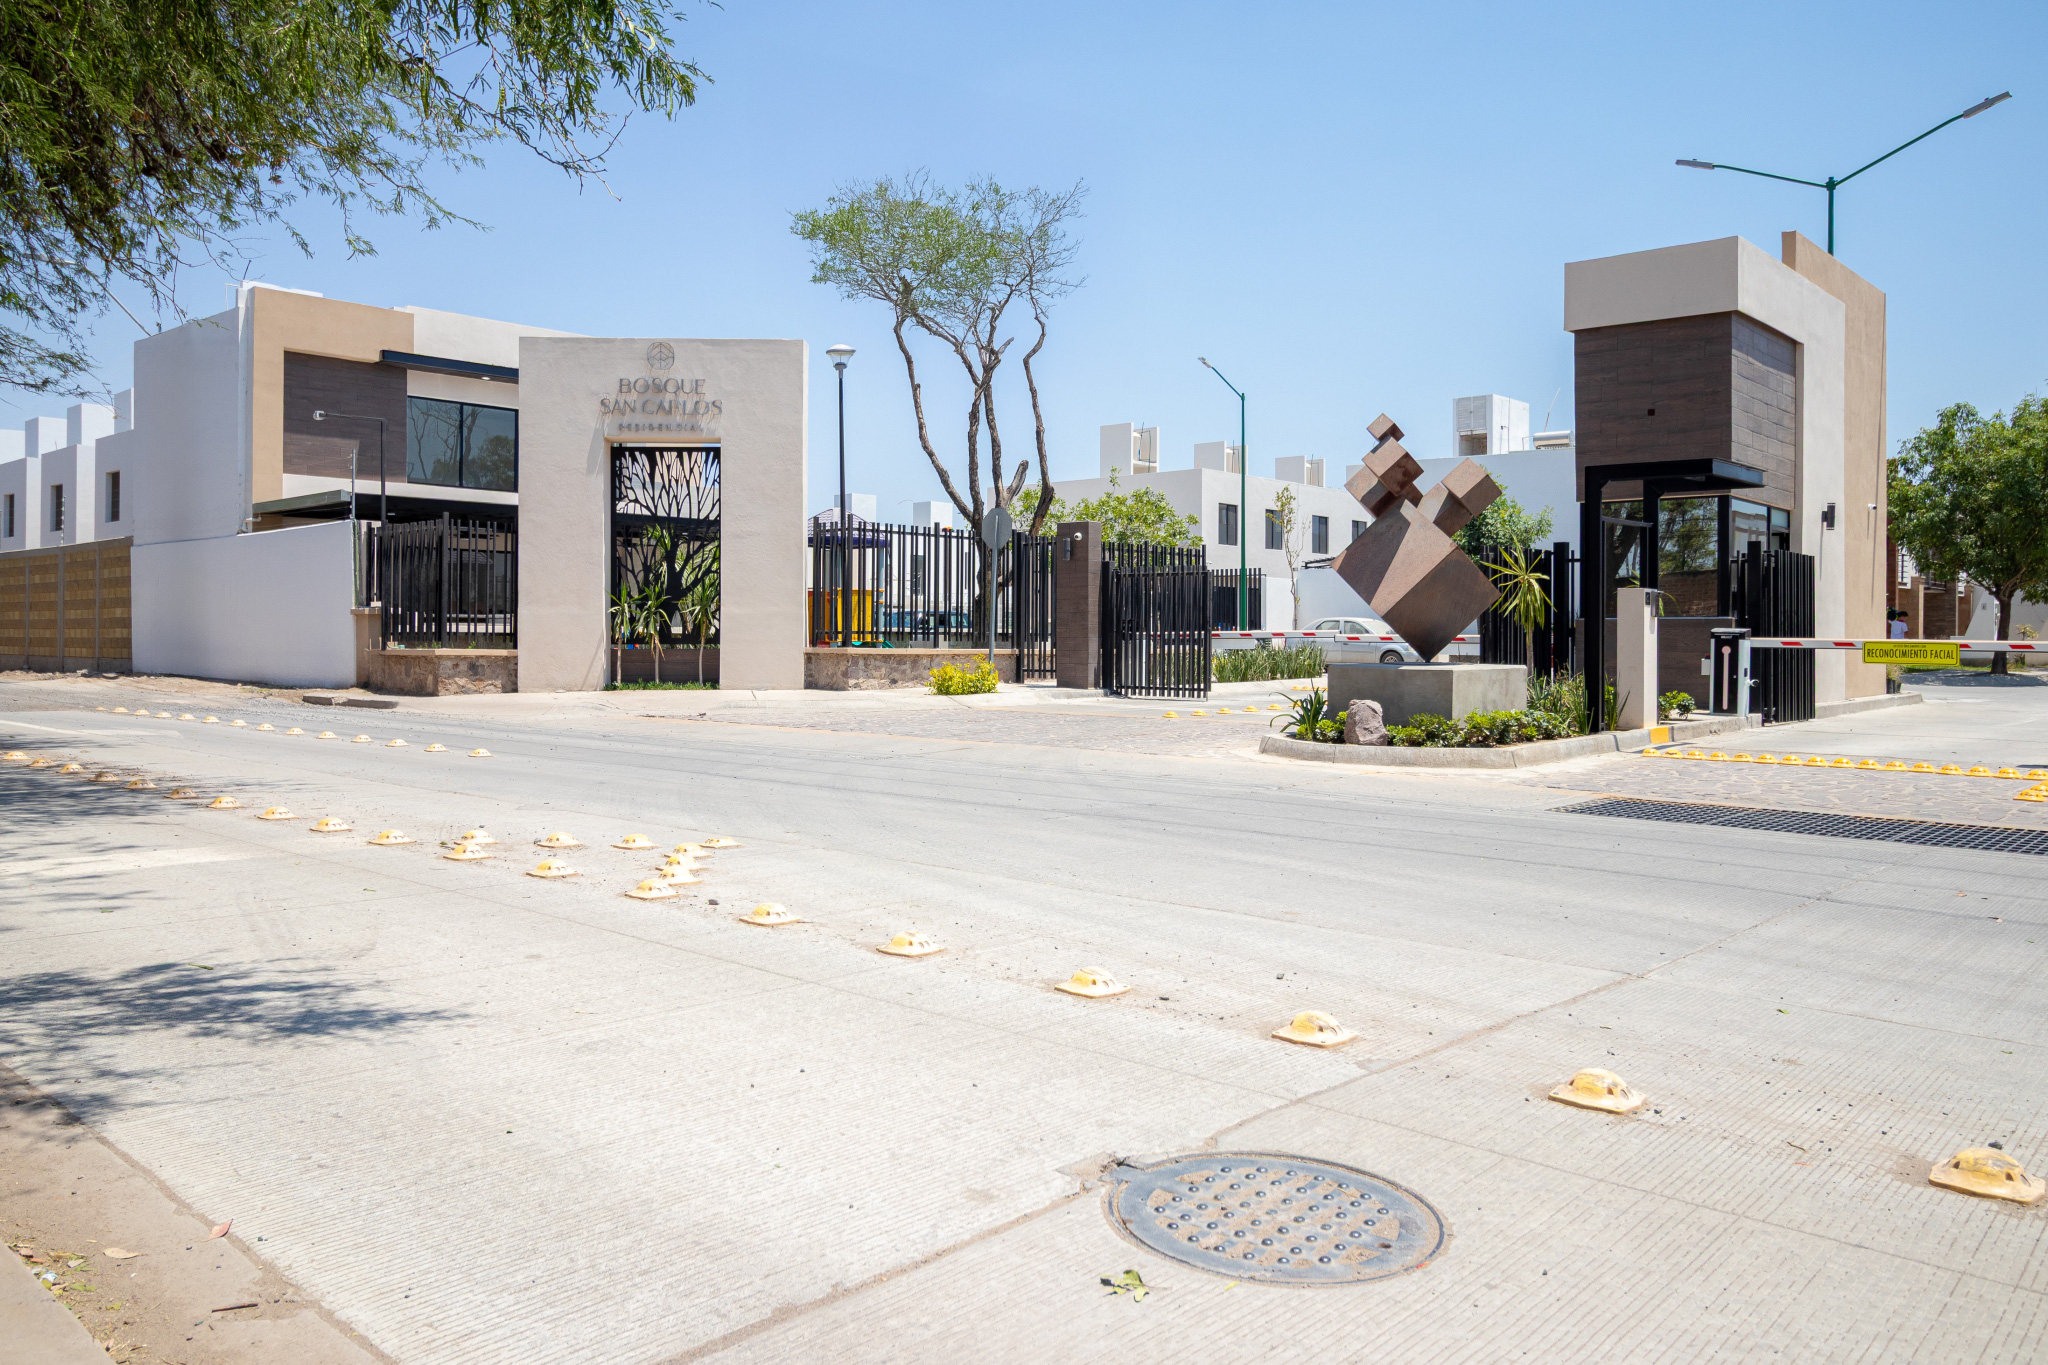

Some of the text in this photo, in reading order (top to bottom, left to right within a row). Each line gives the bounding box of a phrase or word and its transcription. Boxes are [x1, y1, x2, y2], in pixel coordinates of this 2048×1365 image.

[619, 378, 706, 396] BOSQUE
[600, 398, 636, 415] SAN
[1866, 648, 1955, 660] RECONOCIMIENTO FACIAL
